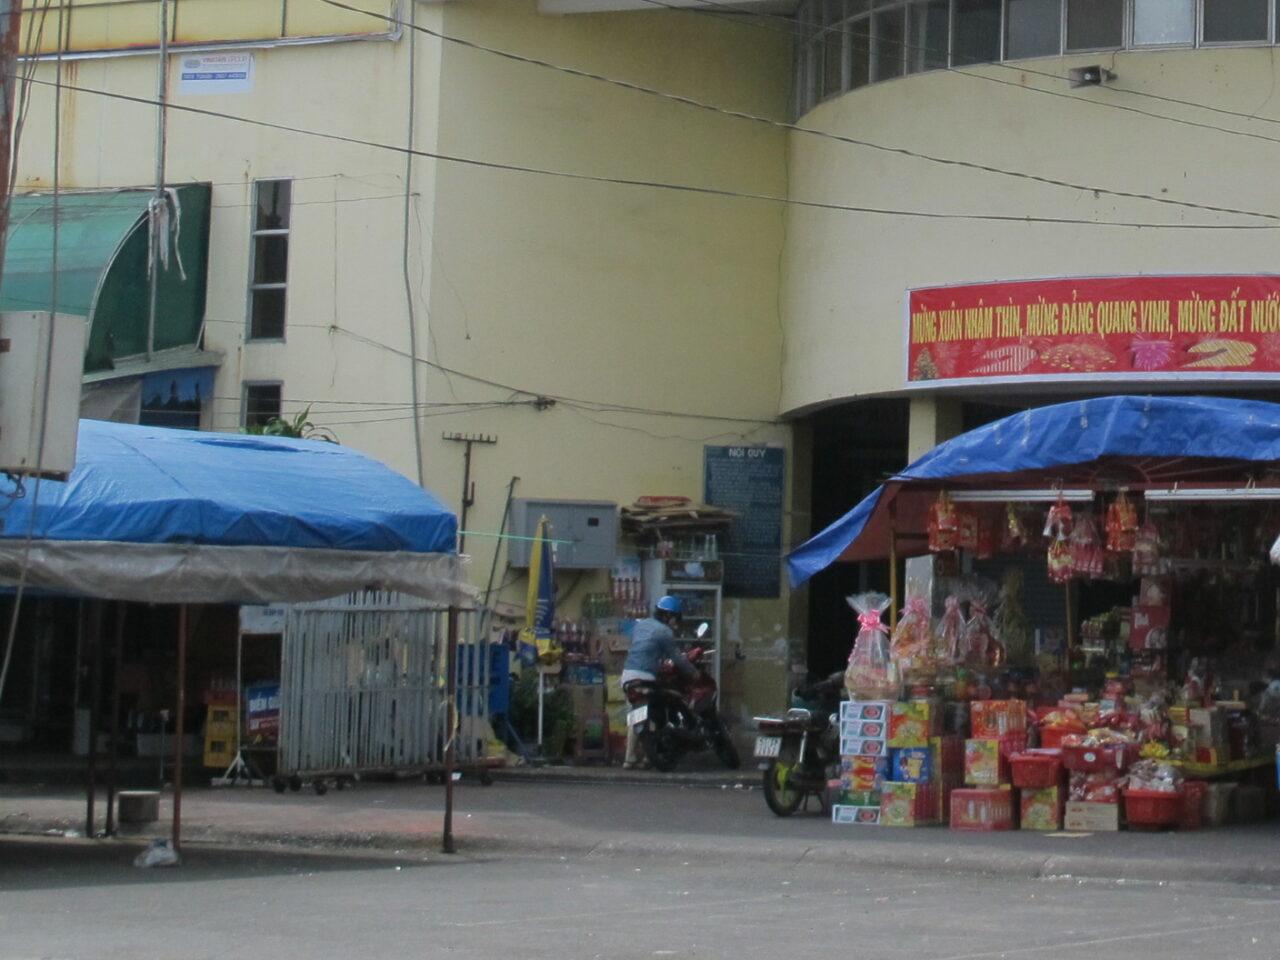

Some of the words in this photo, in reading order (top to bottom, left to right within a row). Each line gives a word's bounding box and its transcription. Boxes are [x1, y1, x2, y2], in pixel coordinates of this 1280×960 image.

[938, 301, 963, 342] XUÂN
[965, 298, 993, 339] NHÂM
[1027, 295, 1059, 336] MỪNG
[1062, 289, 1093, 334] ĐẢNG
[1097, 300, 1137, 340] QUANG
[1178, 291, 1216, 333] MỪNG
[1219, 287, 1247, 333] ĐẤT
